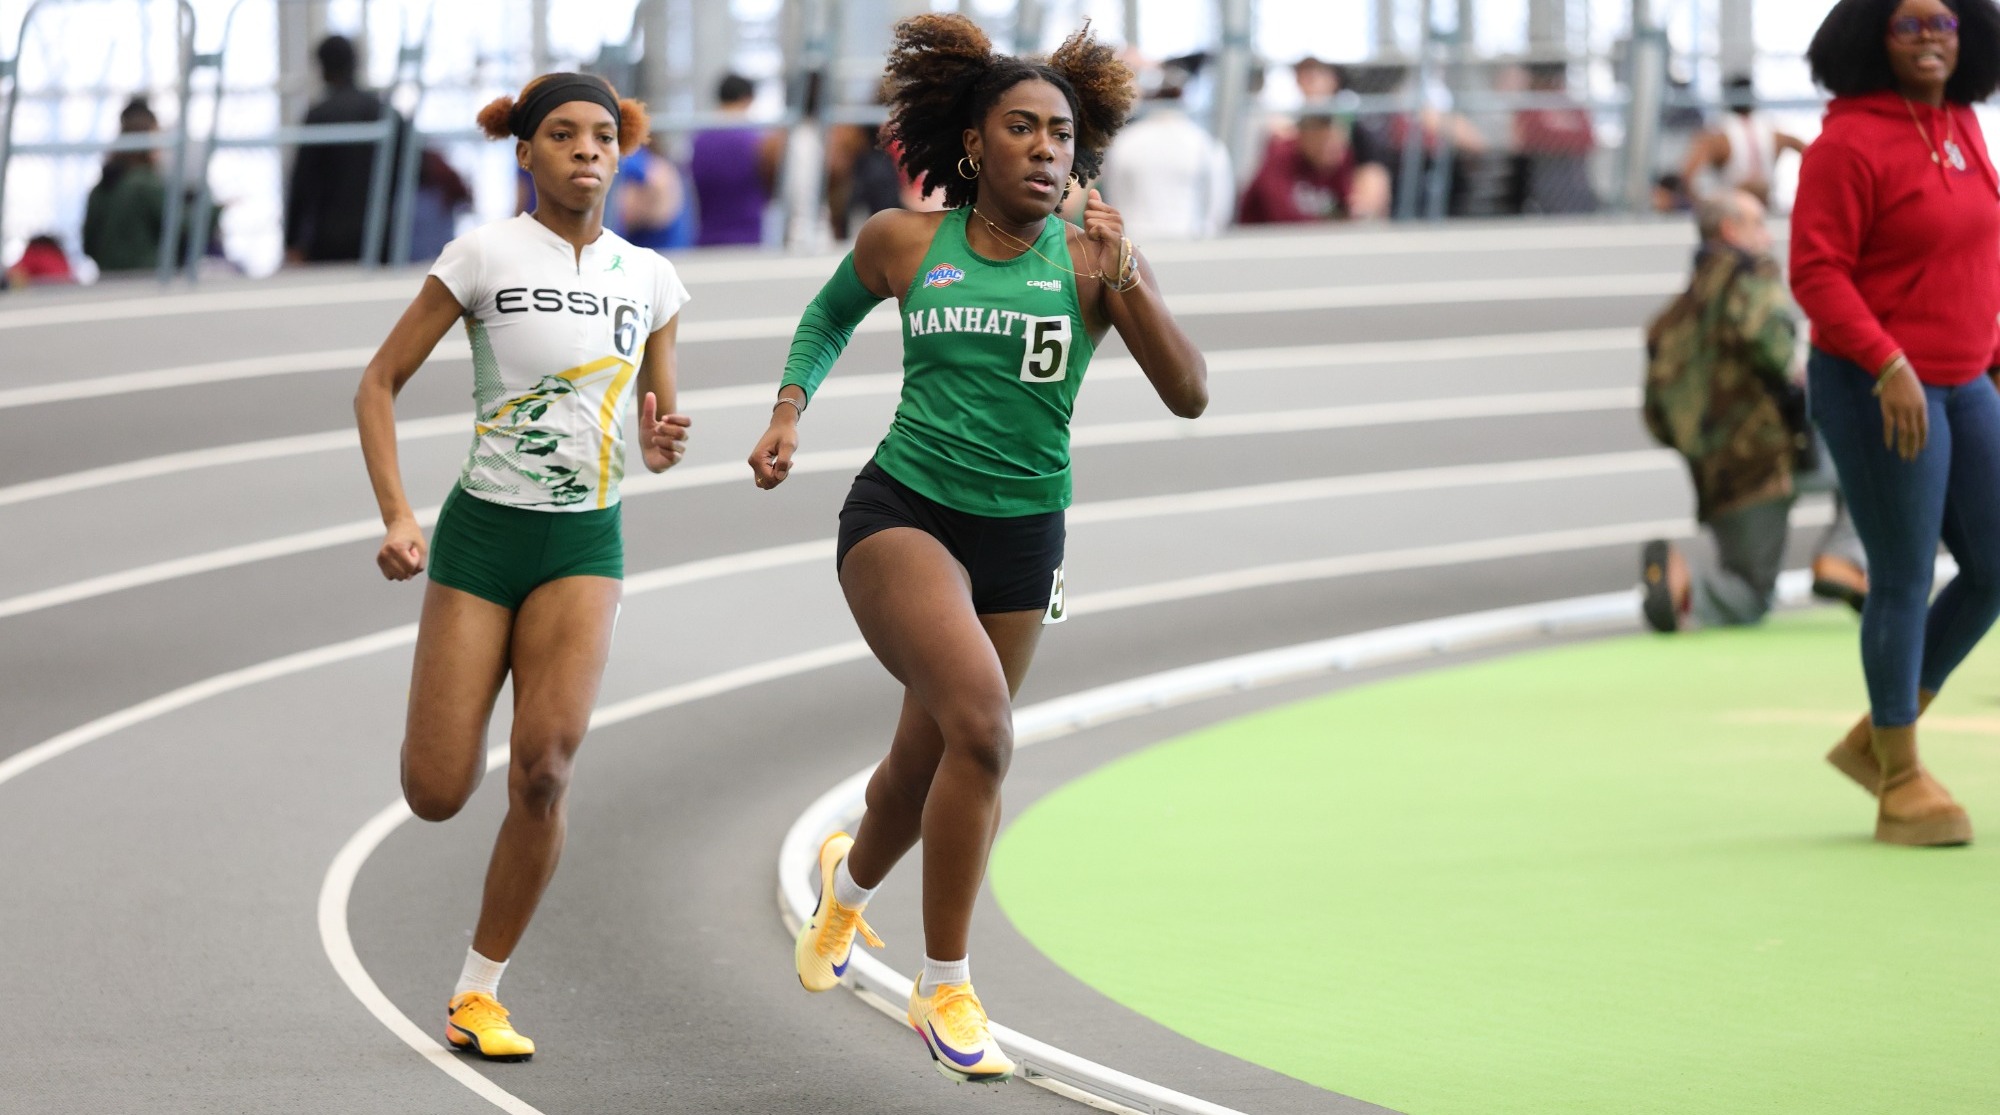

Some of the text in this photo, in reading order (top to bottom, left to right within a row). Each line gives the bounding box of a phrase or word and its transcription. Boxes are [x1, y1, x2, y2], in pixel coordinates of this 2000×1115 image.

[924, 268, 964, 286] MAAC
[1026, 279, 1062, 290] capelli
[495, 288, 649, 329] ESS
[614, 304, 640, 357] 6
[1028, 320, 1063, 379] 5
[1051, 563, 1065, 620] 5
